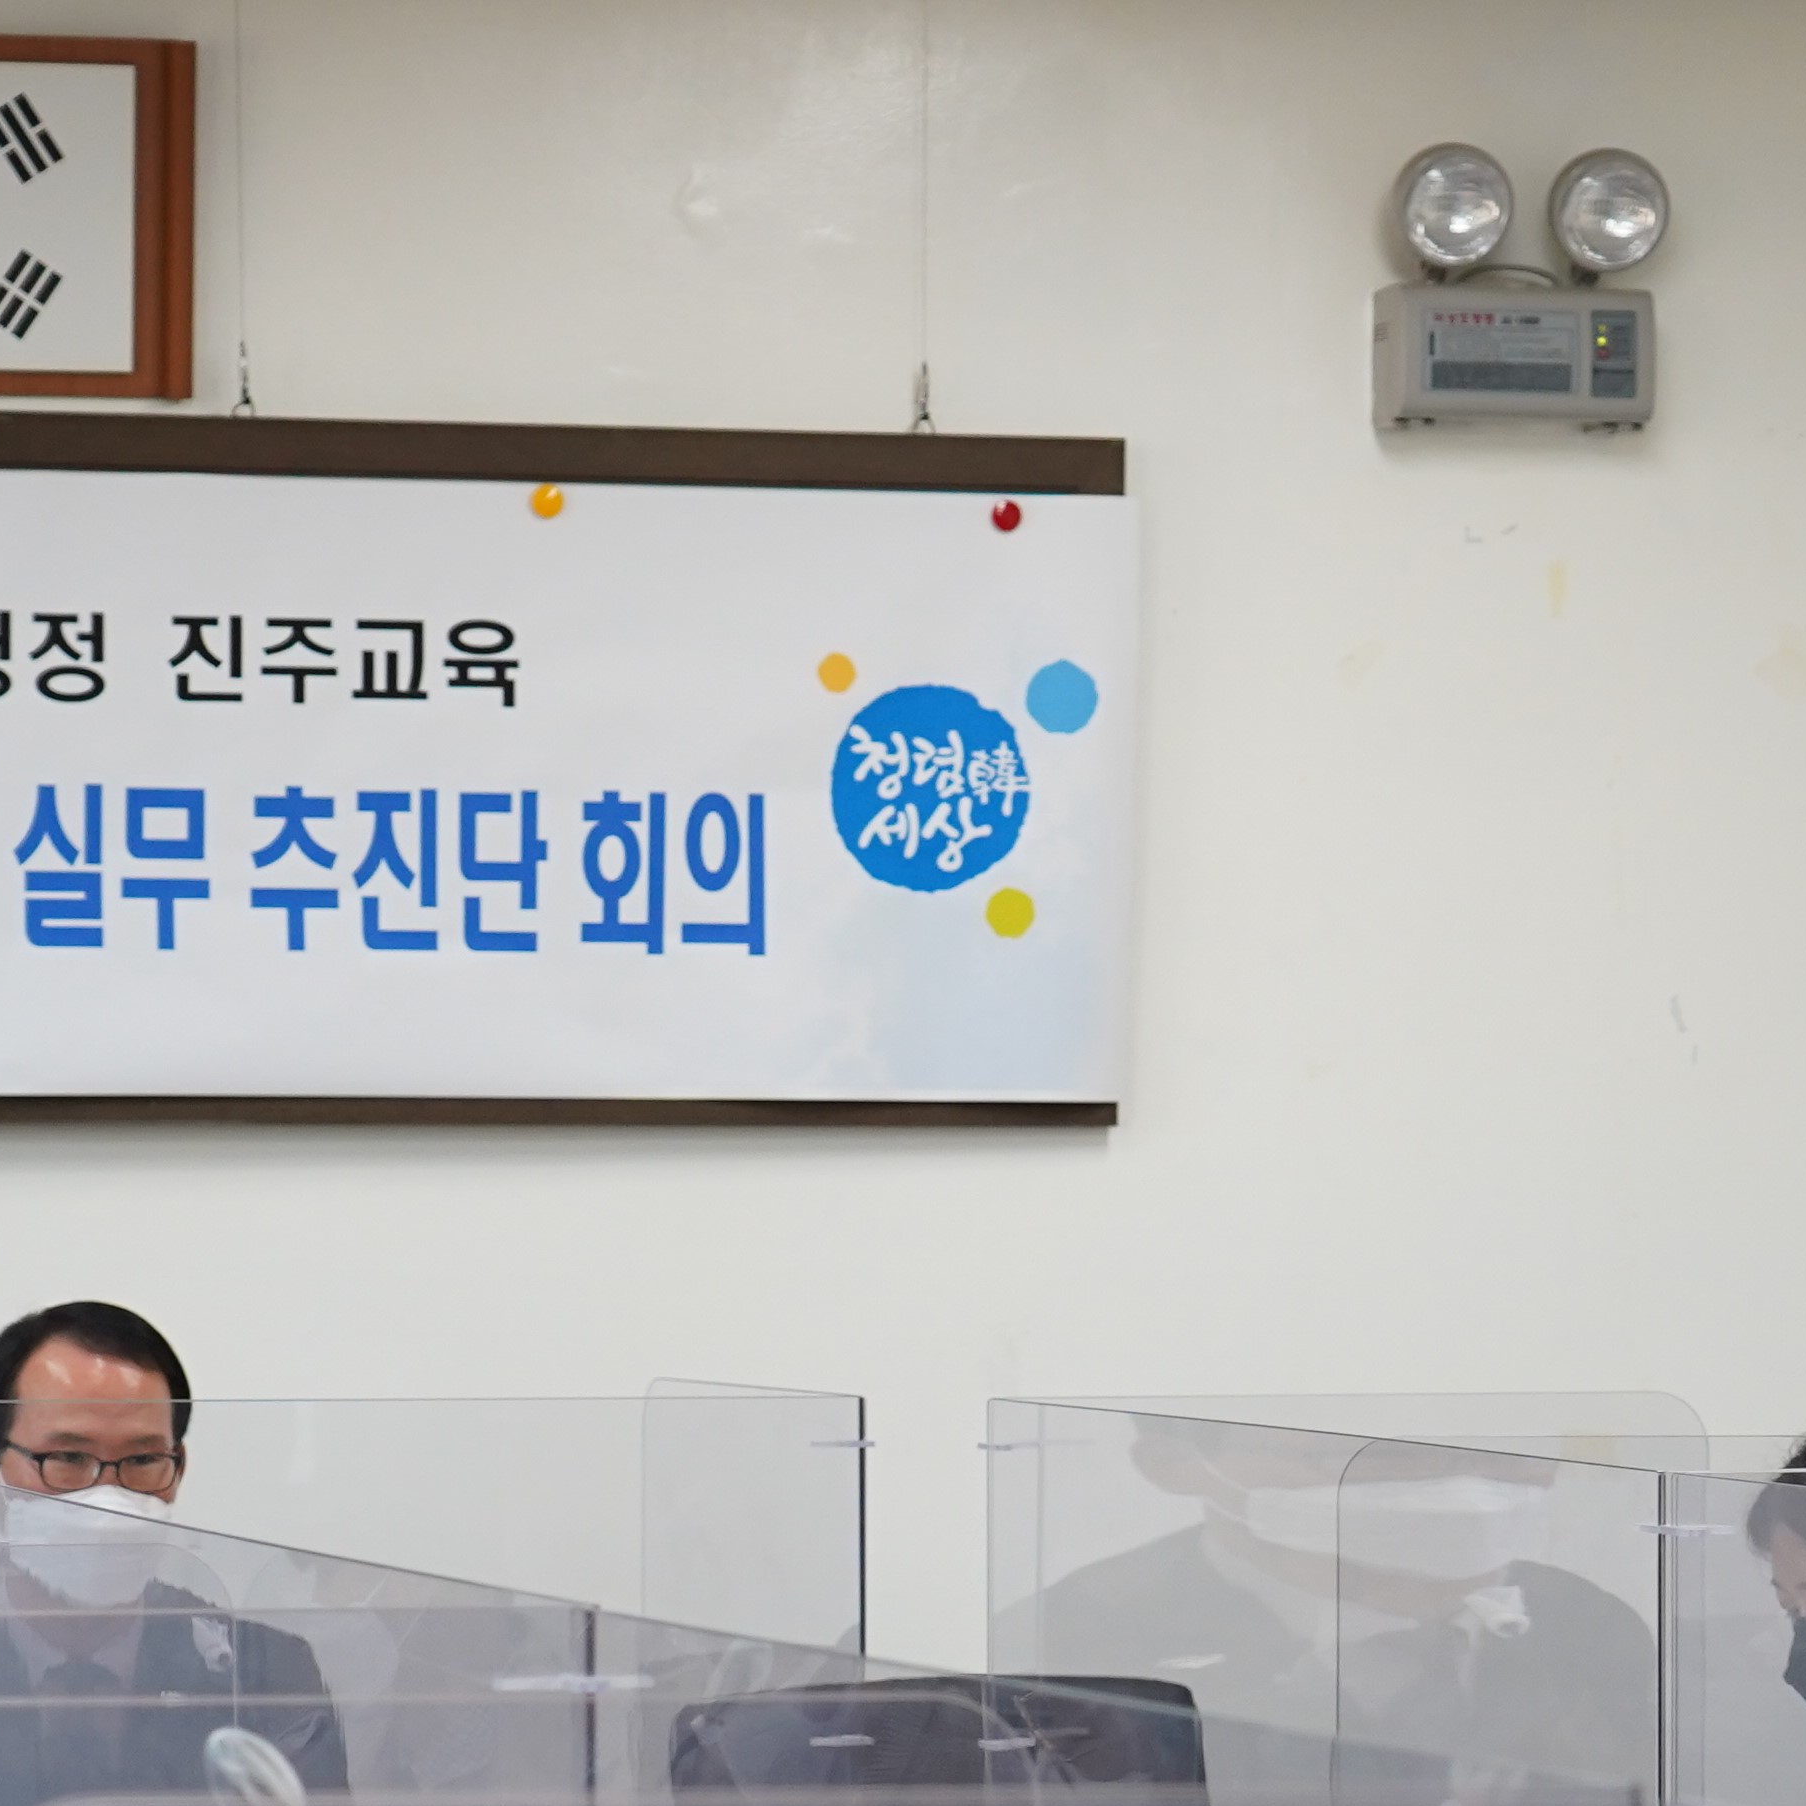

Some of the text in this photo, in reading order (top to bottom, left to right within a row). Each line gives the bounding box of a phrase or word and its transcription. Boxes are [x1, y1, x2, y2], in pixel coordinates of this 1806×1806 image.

[168, 614, 519, 708] 진주교육
[13, 782, 212, 952] 실무
[248, 784, 549, 954] 추진단
[578, 789, 768, 957] 회의
[857, 796, 993, 873] 세상
